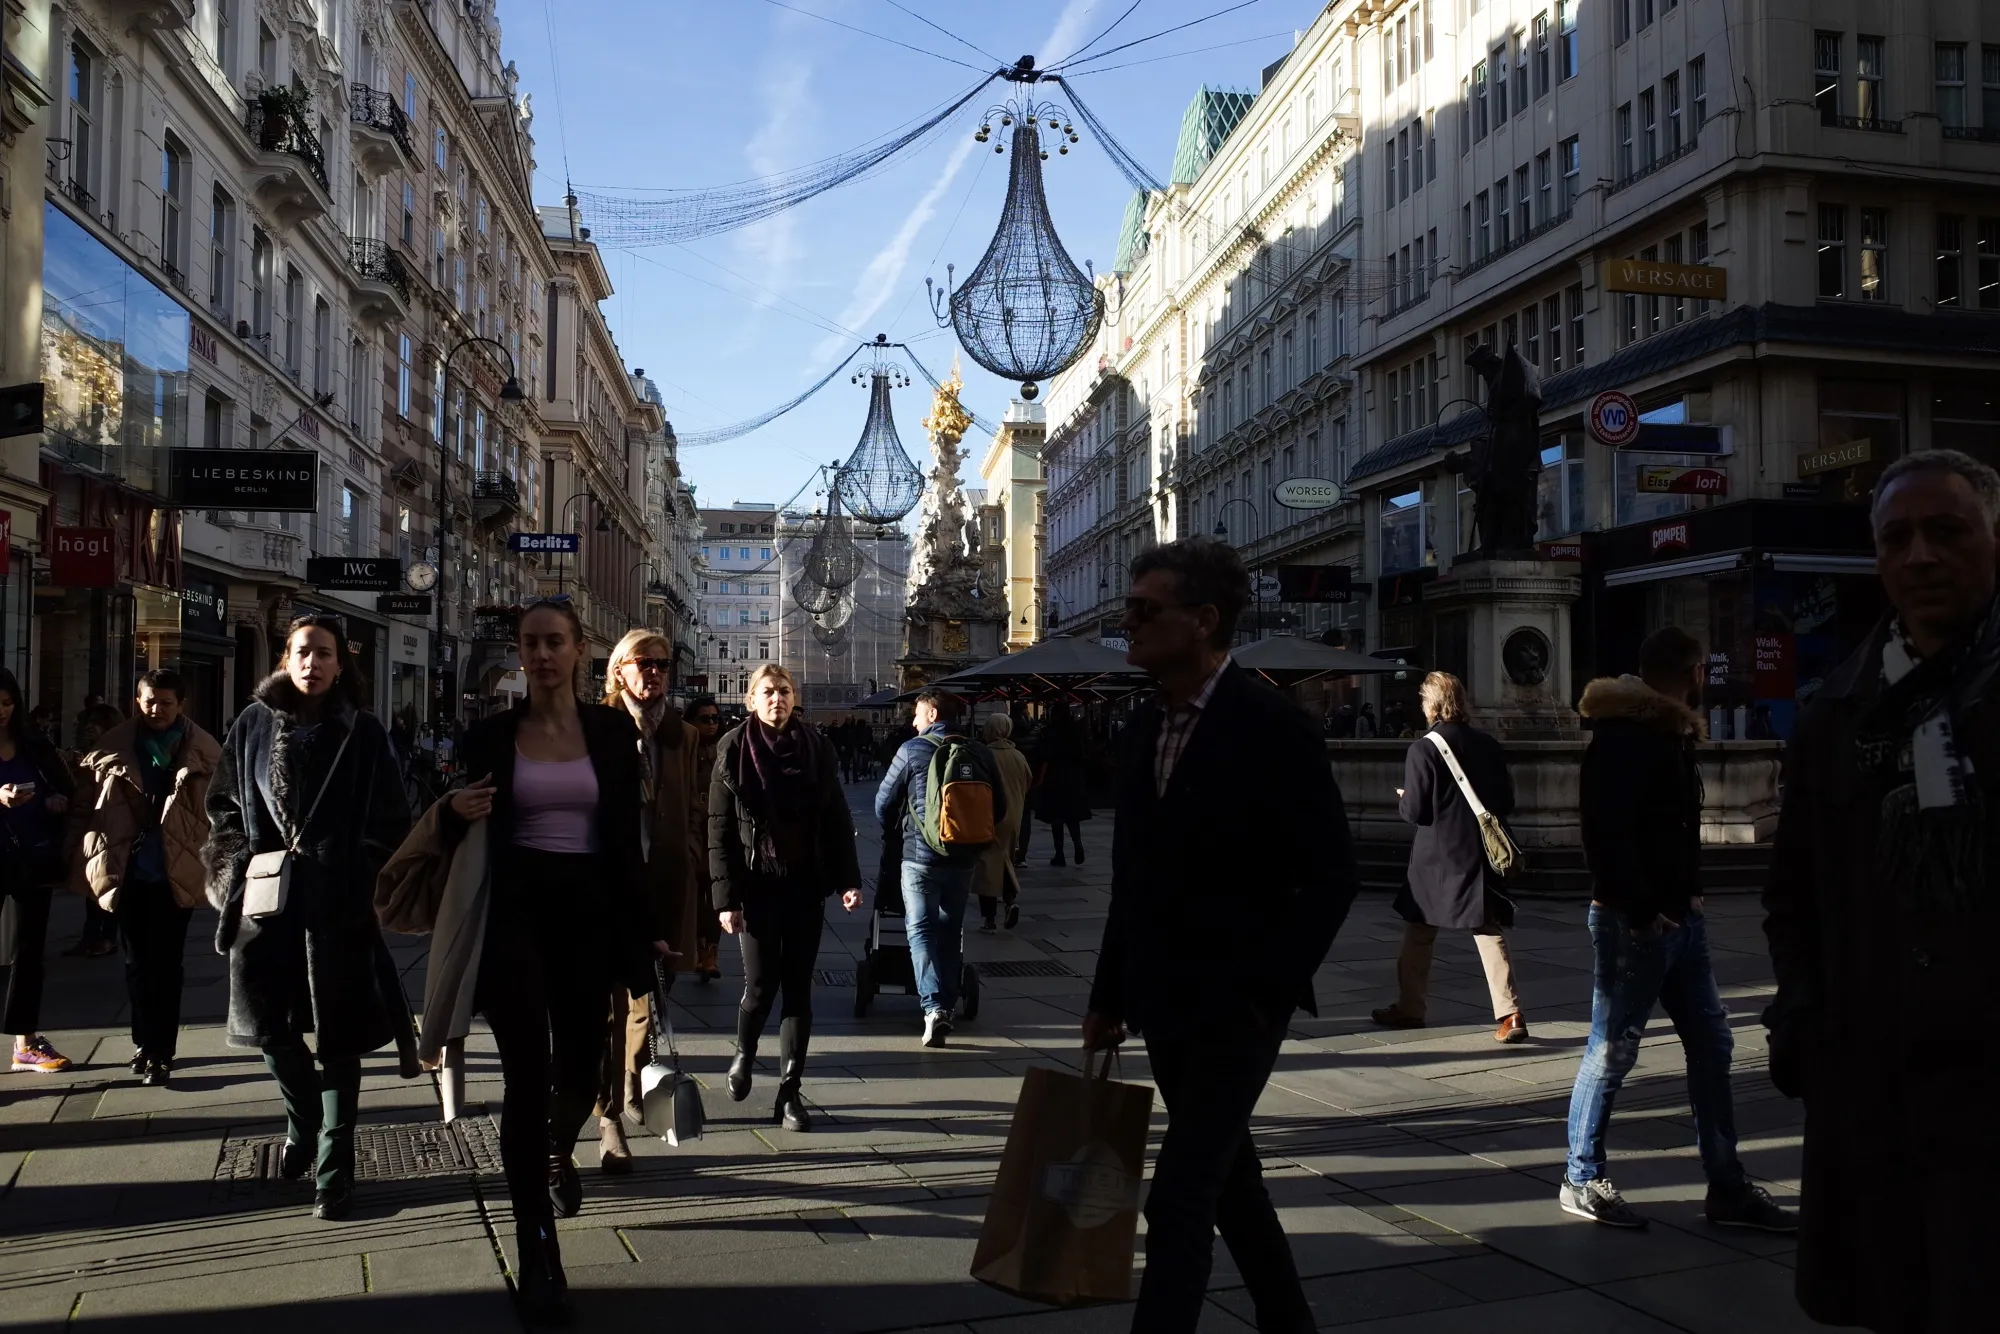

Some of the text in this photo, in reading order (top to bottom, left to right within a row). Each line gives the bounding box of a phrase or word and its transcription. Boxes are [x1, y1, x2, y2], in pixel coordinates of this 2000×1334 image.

[1623, 267, 1714, 289] VERSACE
[1603, 409, 1625, 426] VVD
[1803, 445, 1864, 470] VERSACE
[192, 467, 311, 481] LIEBESKIND
[1285, 486, 1331, 496] WORSEG
[519, 535, 571, 549] Berlitz
[1652, 525, 1686, 549] CAMPER
[1550, 546, 1581, 558] CAMPER
[343, 562, 377, 577] IWC
[330, 578, 388, 586] SCHAFFHAUSEN
[181, 588, 213, 606] EBESKIND
[391, 601, 420, 609] BALLY
[1756, 637, 1782, 649] Walk,
[1709, 653, 1730, 663] Walk,
[1756, 649, 1782, 659] Don't
[1756, 660, 1778, 671] Run.
[1709, 675, 1726, 685] Run.
